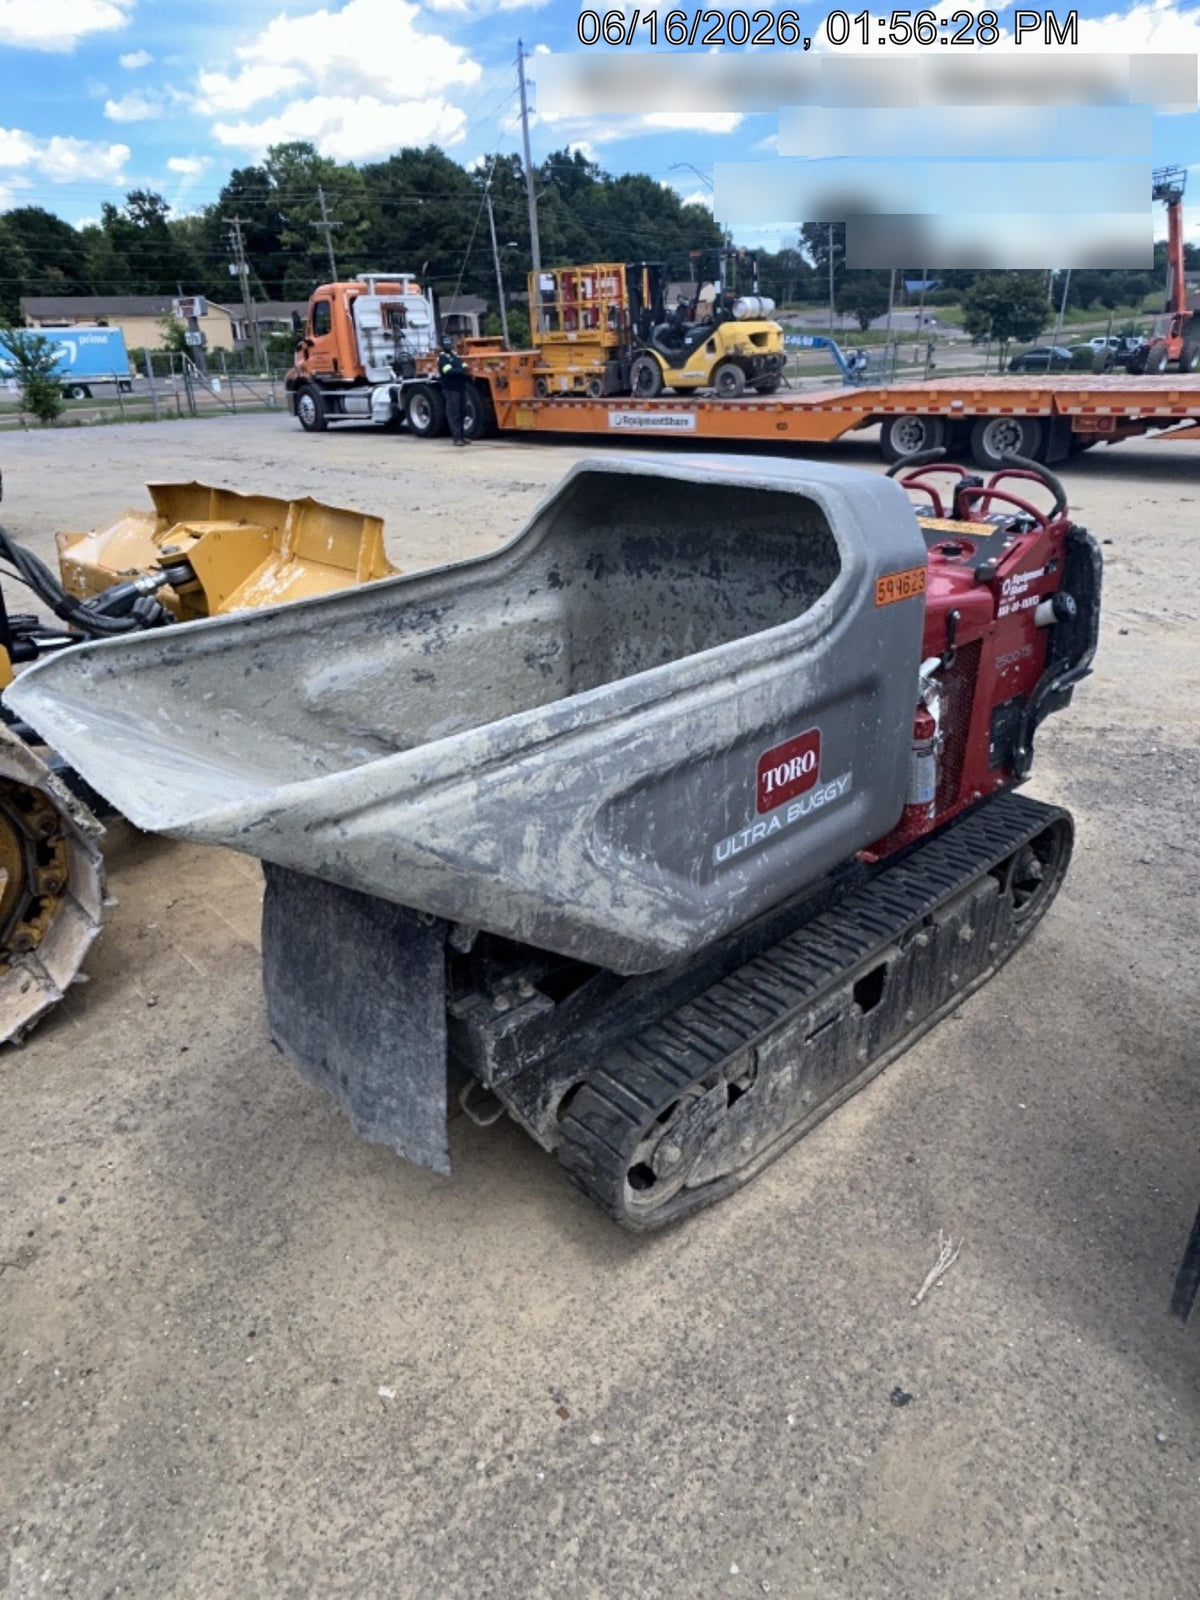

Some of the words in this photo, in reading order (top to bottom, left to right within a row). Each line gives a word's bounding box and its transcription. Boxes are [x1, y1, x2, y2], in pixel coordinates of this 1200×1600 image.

[79, 333, 108, 346] prime
[623, 415, 689, 427] EquipmentShare
[878, 570, 926, 601] 594623
[762, 750, 816, 793] TORO
[715, 815, 782, 862] ULTRA
[787, 775, 848, 823] BUGGY
